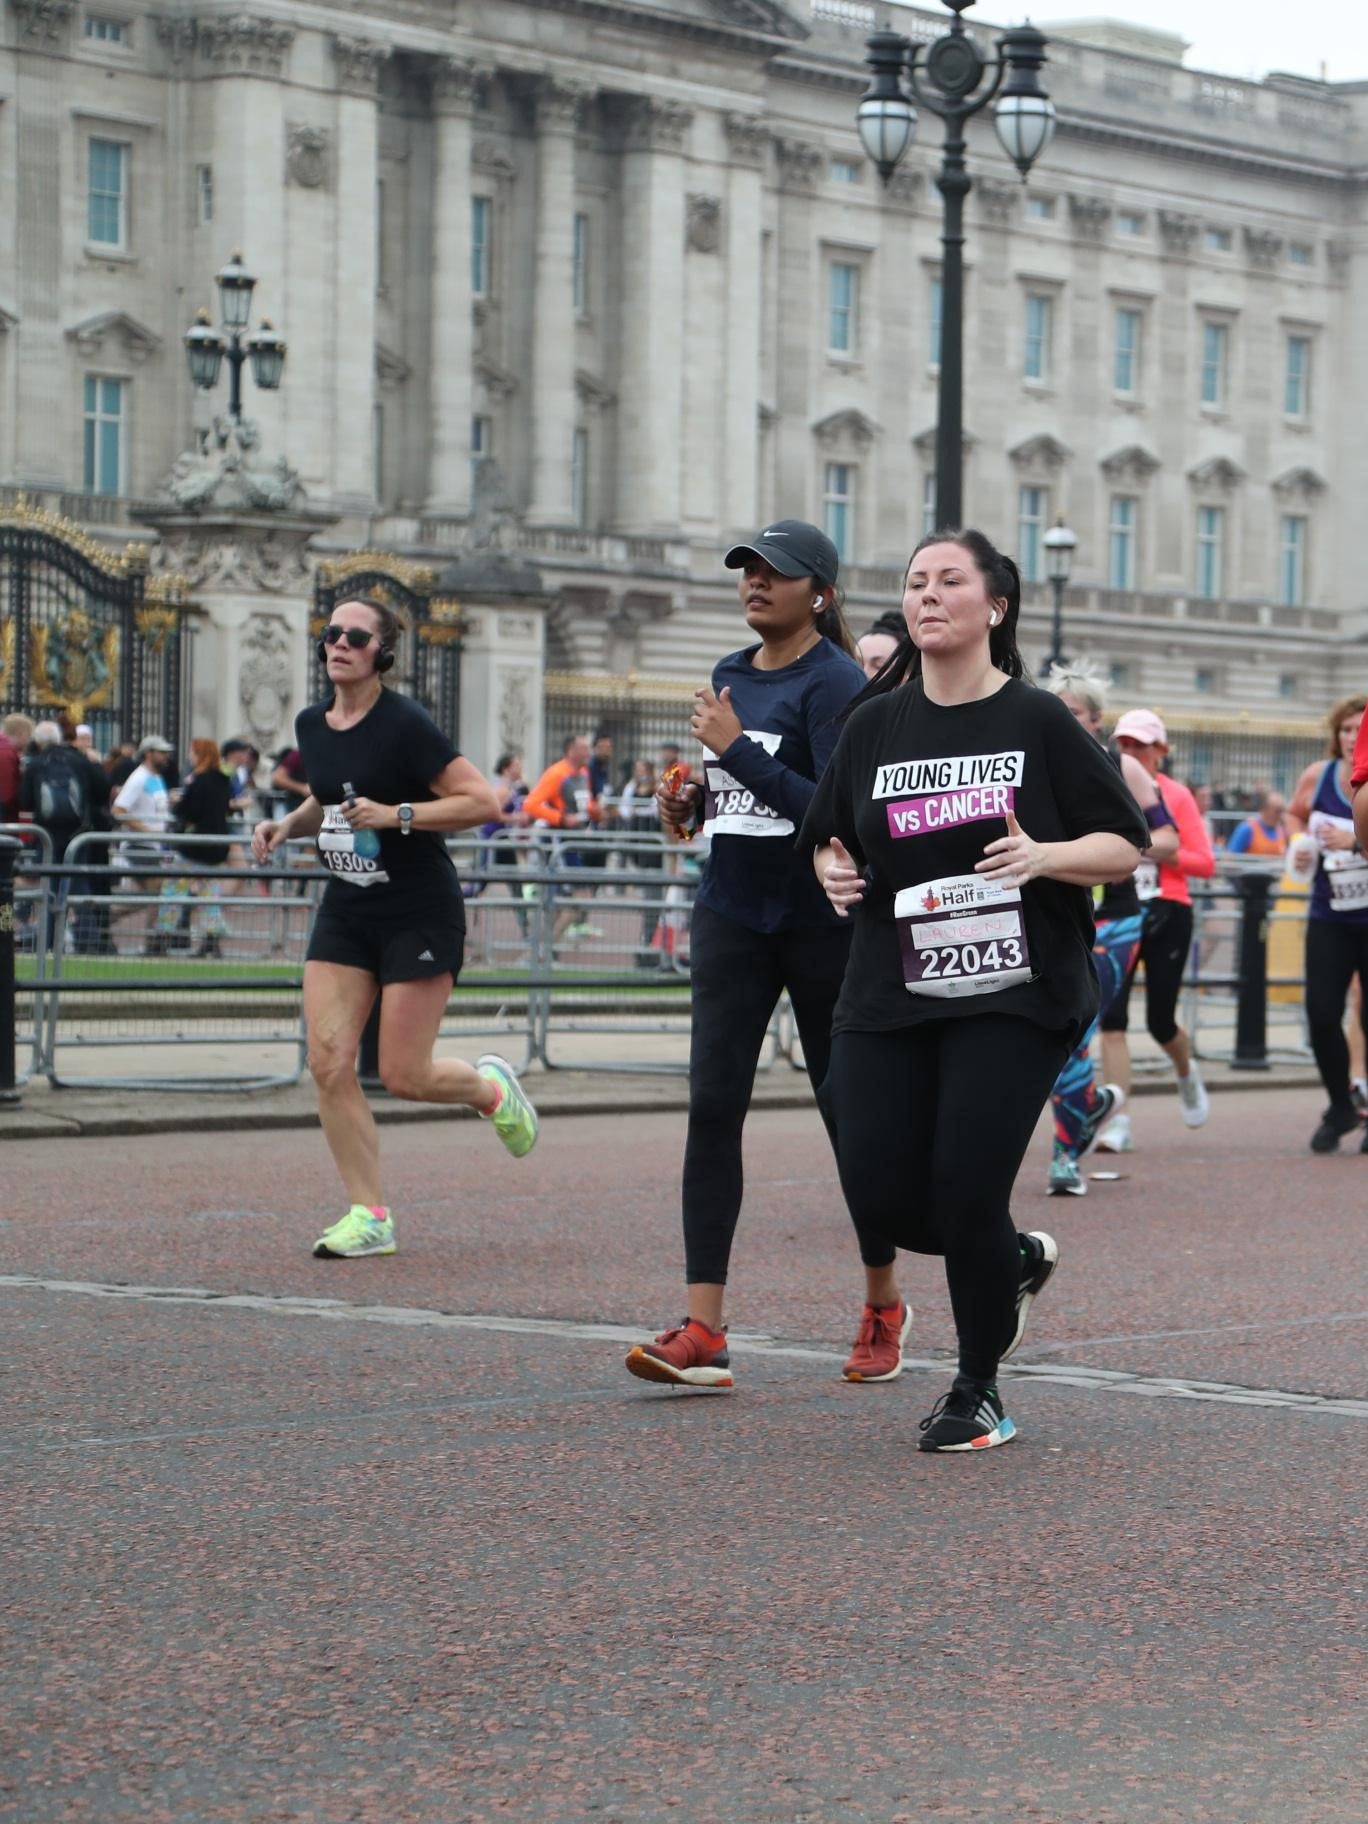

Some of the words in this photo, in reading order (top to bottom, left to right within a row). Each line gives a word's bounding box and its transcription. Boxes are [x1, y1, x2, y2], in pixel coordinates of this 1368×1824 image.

[881, 762, 952, 794] YOUNG
[957, 755, 1018, 786] LIVES
[924, 786, 1008, 827] CANCER
[942, 889, 974, 906] Half
[918, 921, 1002, 943] LAUREN
[920, 938, 1023, 979] 22043
